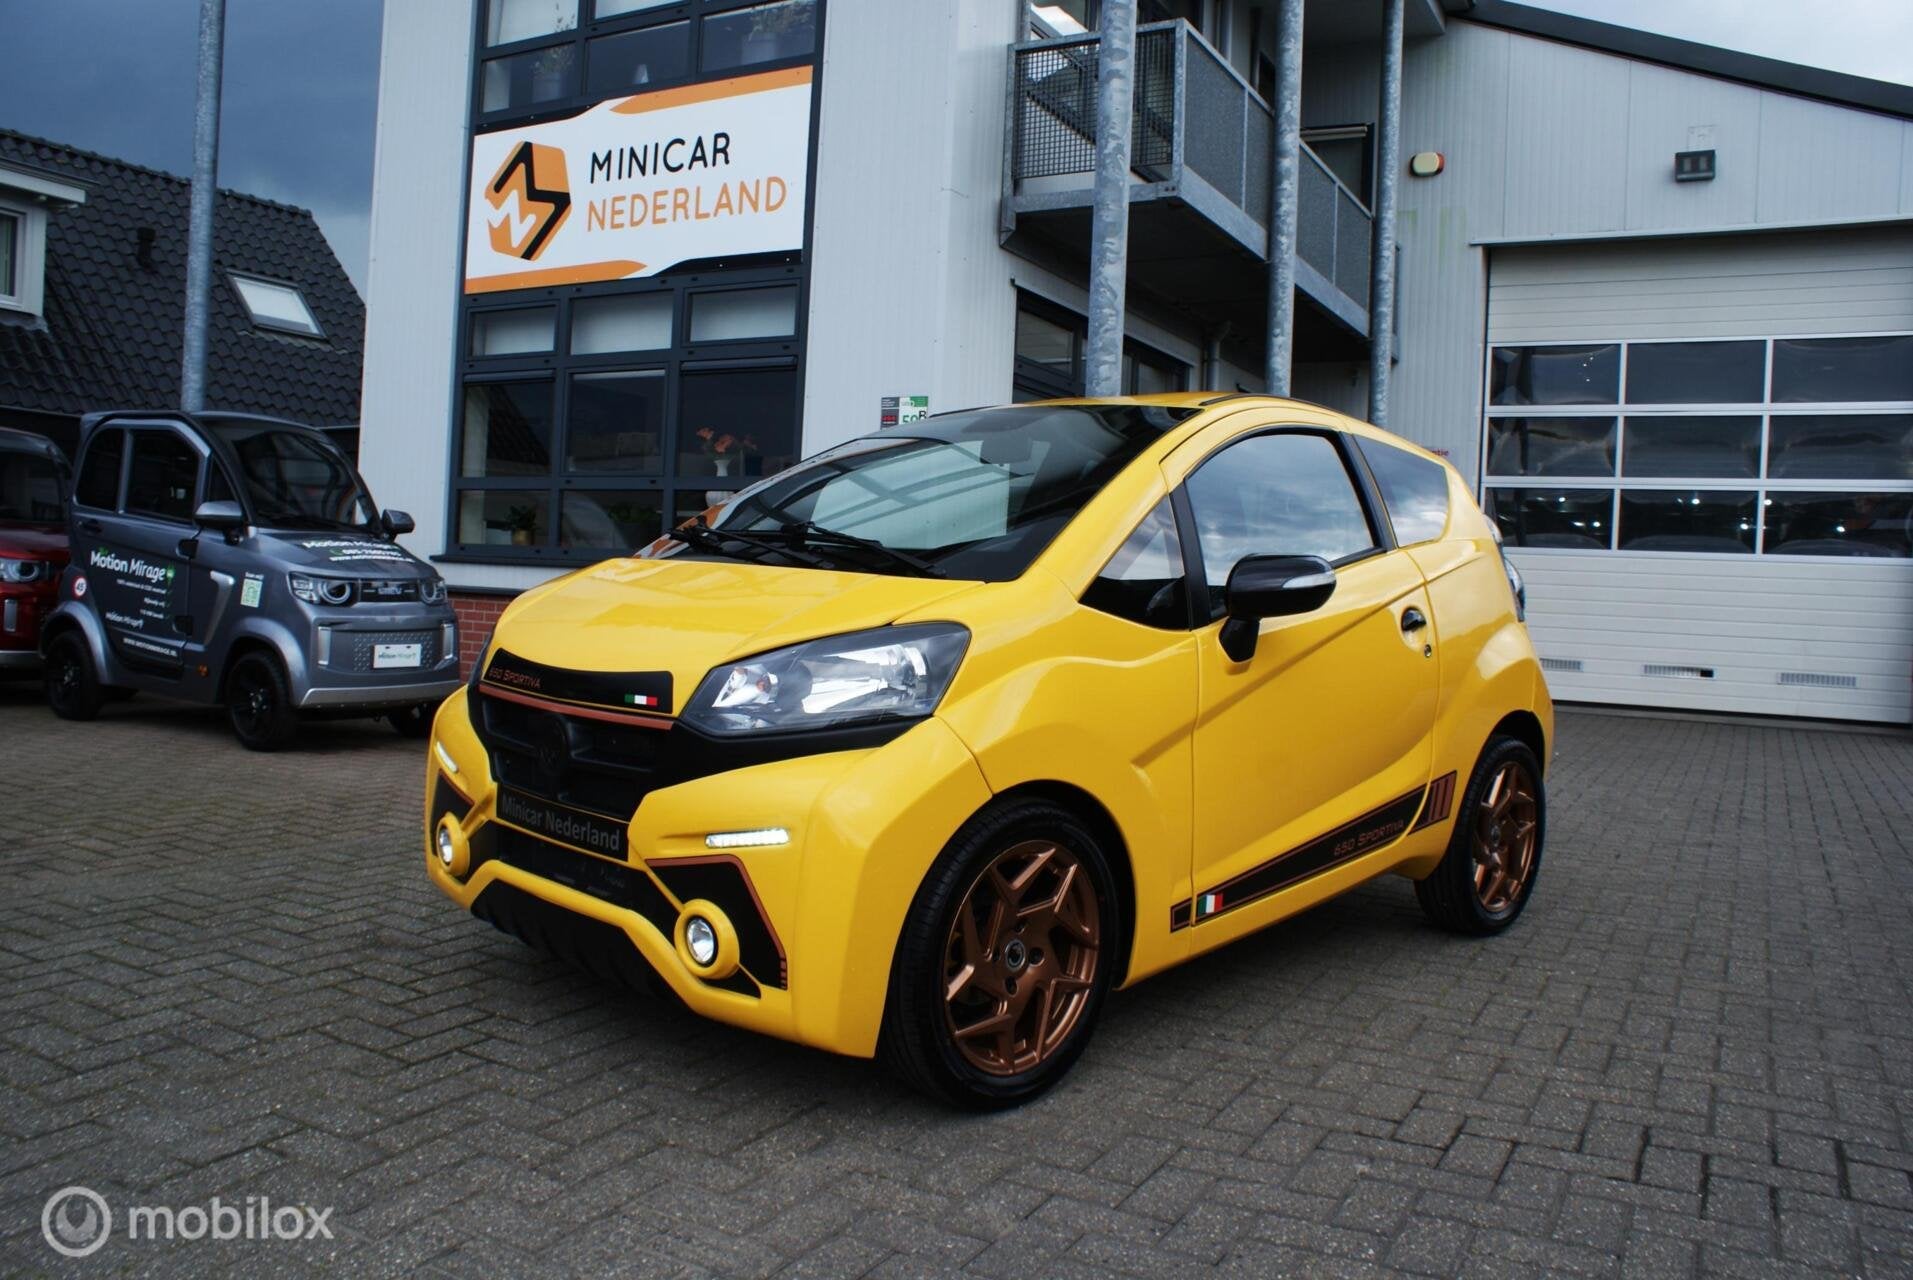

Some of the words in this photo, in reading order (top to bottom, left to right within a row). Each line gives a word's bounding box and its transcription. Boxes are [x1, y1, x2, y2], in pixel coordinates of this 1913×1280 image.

[590, 132, 731, 184] MINICAR
[587, 176, 787, 232] NEDERLAND
[90, 550, 128, 572] Motion
[129, 558, 166, 583] Mirage
[502, 793, 543, 826] Minicar
[546, 810, 620, 850] Nederland
[1357, 819, 1404, 846] SPORTIVA
